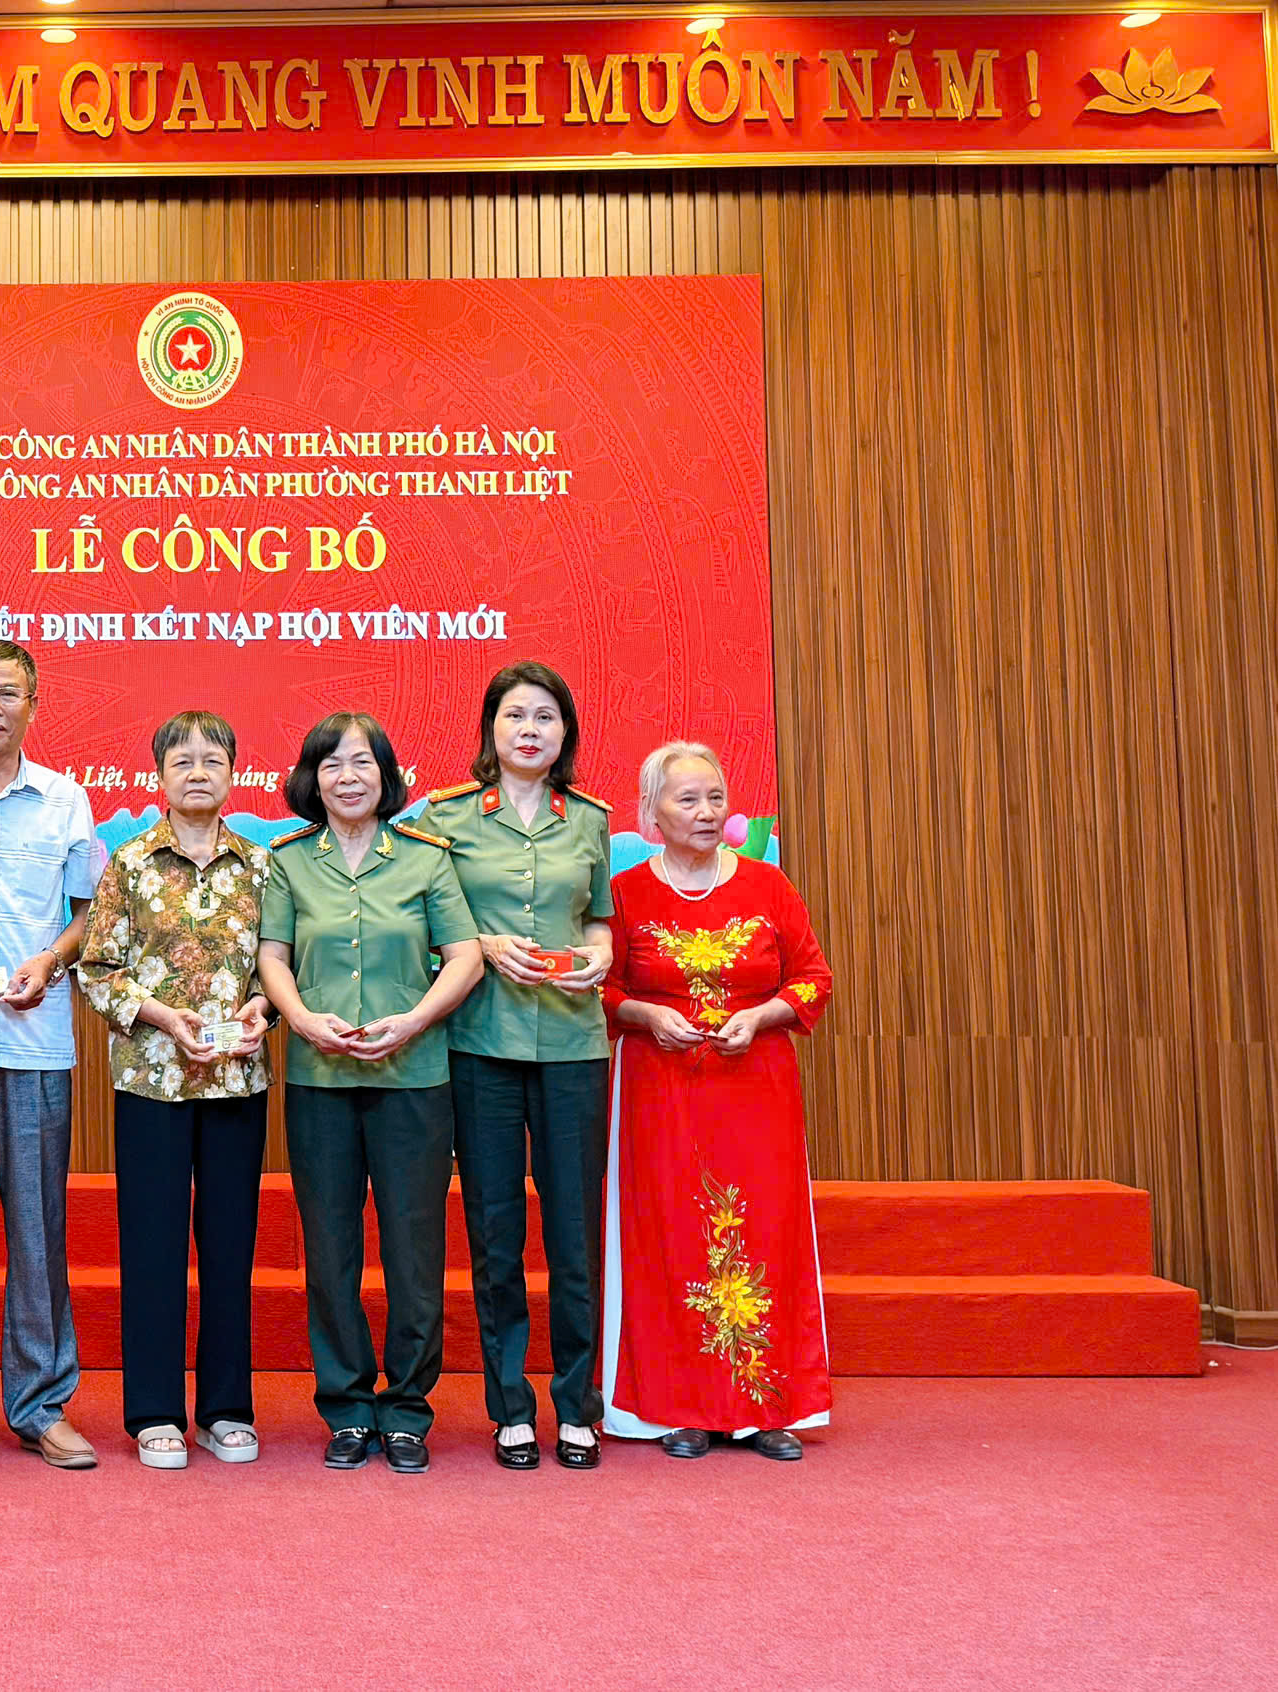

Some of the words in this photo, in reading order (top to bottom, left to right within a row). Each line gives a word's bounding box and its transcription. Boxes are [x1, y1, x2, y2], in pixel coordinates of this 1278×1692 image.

[59, 59, 327, 138] QUANG
[343, 54, 546, 128] VINH
[563, 30, 800, 124] MUÔN
[819, 28, 1002, 121] NĂM
[81, 435, 122, 459] AN
[126, 427, 209, 459] NHÂN
[213, 426, 274, 458] DÂN
[279, 426, 382, 458] THÀNH
[387, 424, 448, 457] PHỐ
[454, 424, 498, 456] HÀ
[502, 427, 556, 462] NỘI
[66, 474, 107, 498] AN
[111, 466, 194, 498] NHÂN
[198, 465, 260, 498] DÂN
[264, 465, 390, 497] PHƯỜNG
[395, 471, 499, 496] THANH
[504, 466, 572, 502] LIỆT
[31, 514, 105, 573] LỄ
[122, 513, 291, 573] CÔNG
[306, 512, 387, 572] BỐ
[40, 613, 126, 648] ĐỊNH
[131, 605, 200, 641] KẾT
[206, 612, 273, 647] NẠP
[278, 608, 342, 647] HỘI
[348, 604, 429, 640] VIÊN
[437, 604, 507, 640] MỚI
[82, 765, 127, 792] Liệt,
